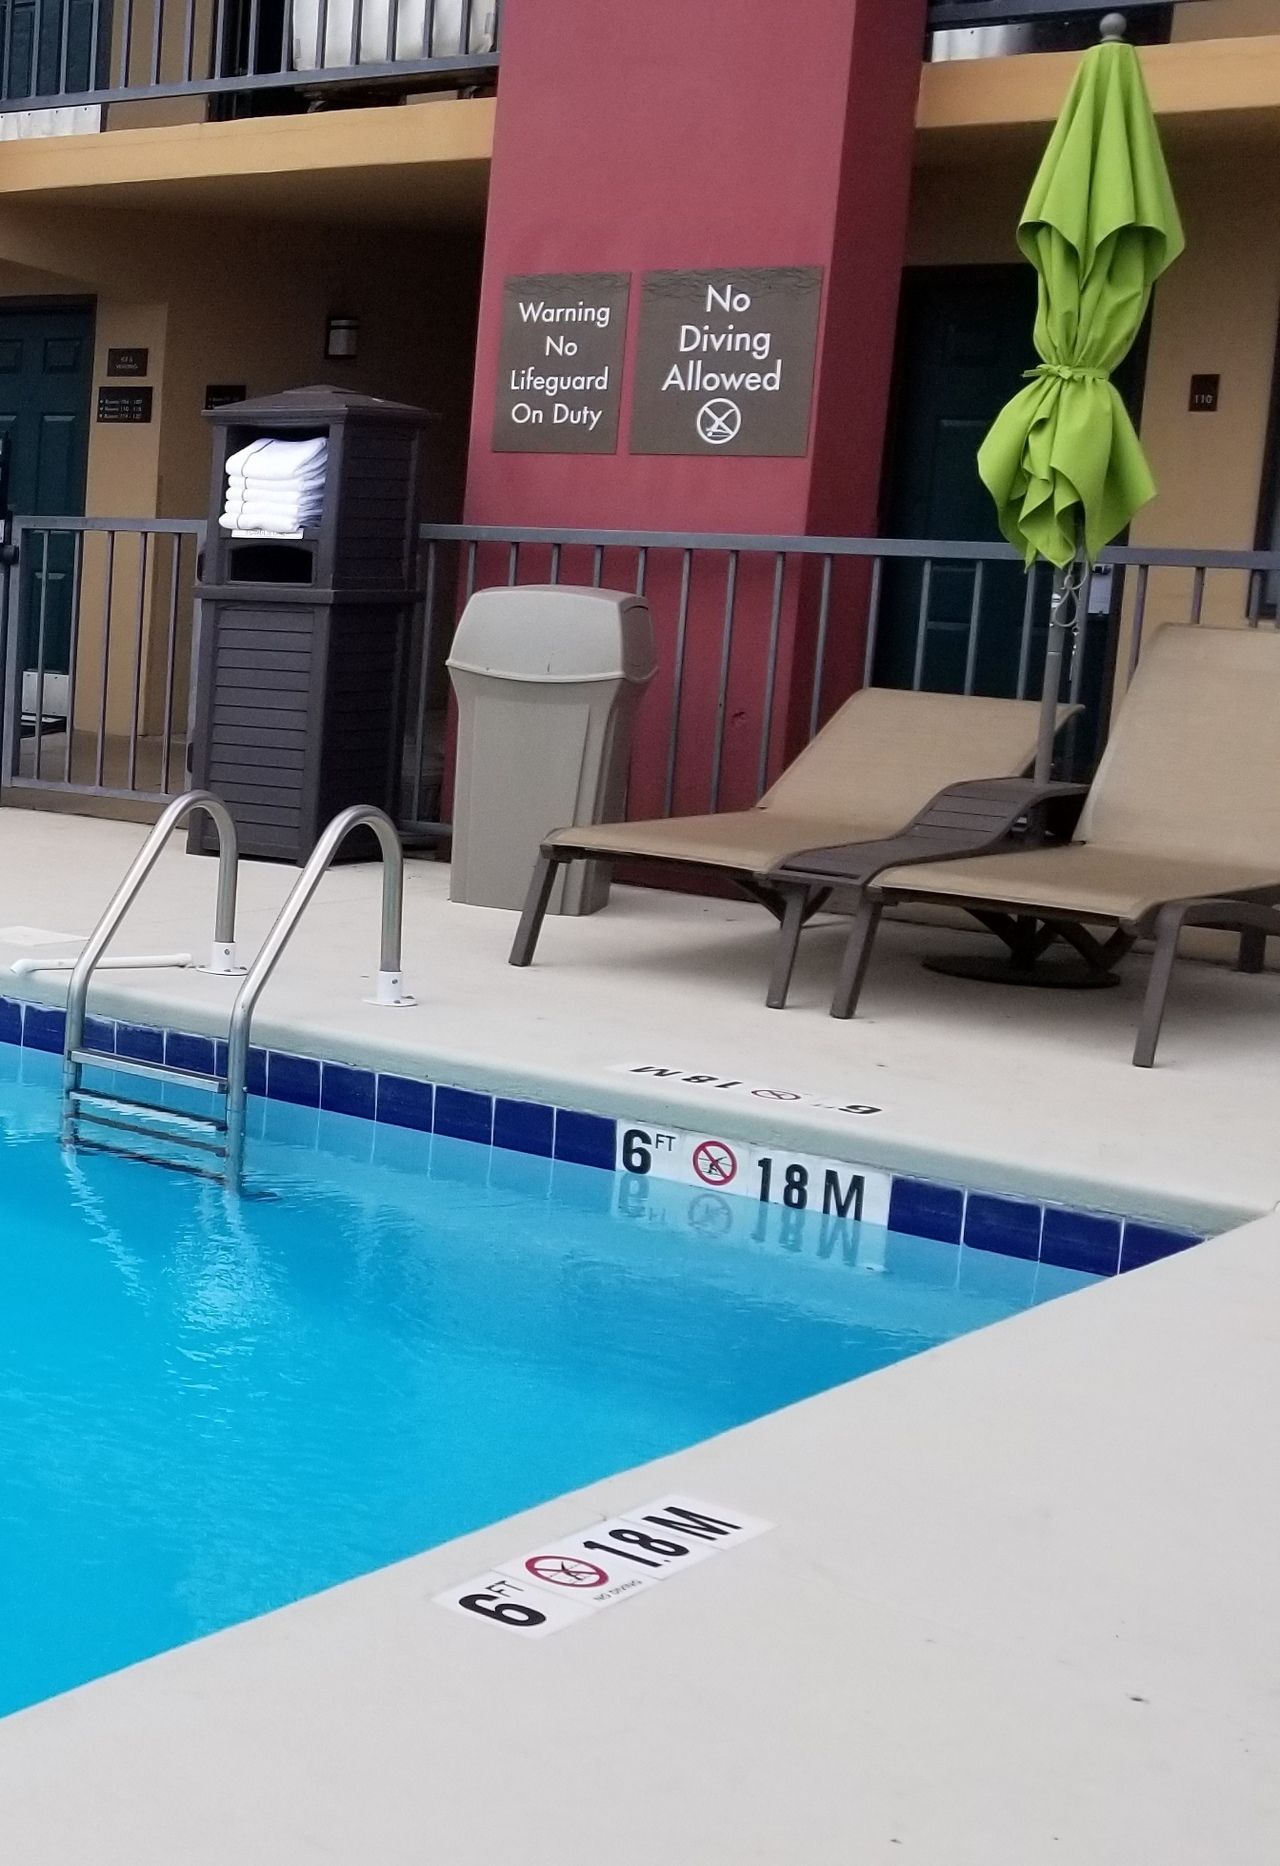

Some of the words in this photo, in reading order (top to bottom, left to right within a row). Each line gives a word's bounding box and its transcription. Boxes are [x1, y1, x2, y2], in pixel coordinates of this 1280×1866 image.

[706, 284, 751, 312] No
[519, 301, 611, 327] Warning
[545, 335, 578, 356] No
[679, 325, 771, 360] Diving
[510, 366, 609, 396] Lifeguard
[661, 359, 782, 391] Allowed
[511, 403, 543, 424] On
[553, 404, 602, 431] Duty
[822, 1169, 866, 1222] M
[641, 1506, 743, 1541] M
